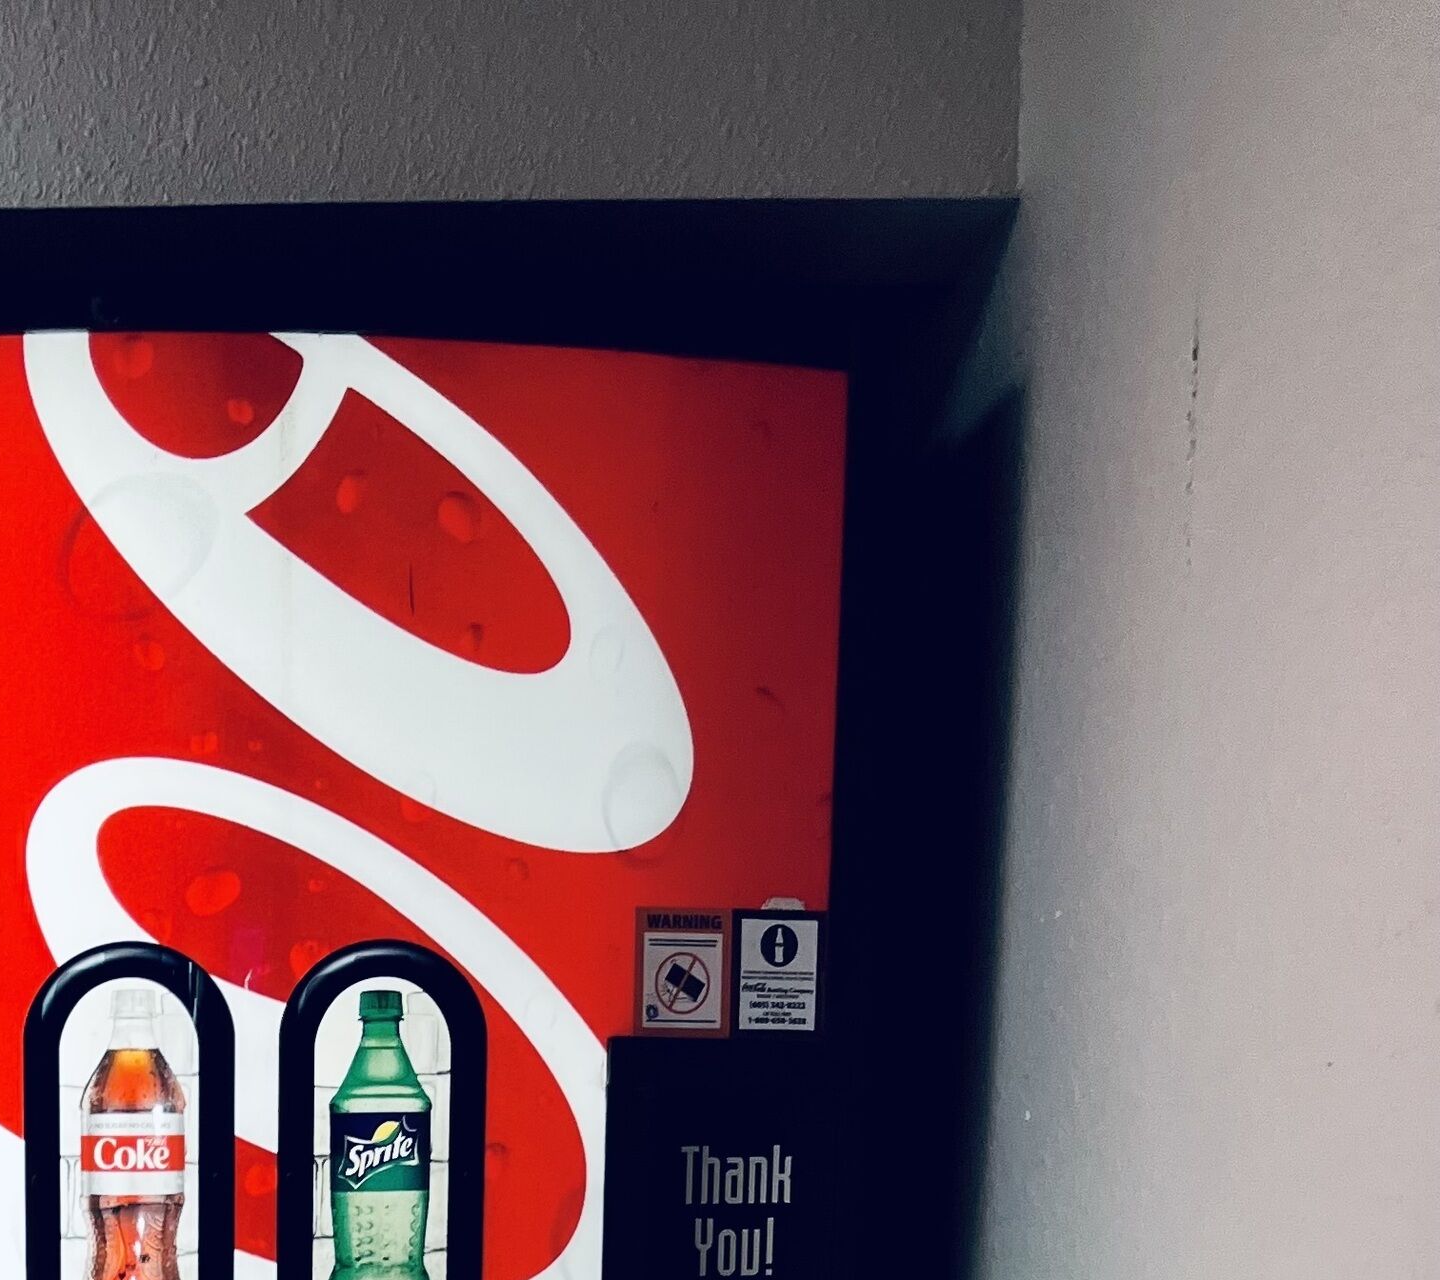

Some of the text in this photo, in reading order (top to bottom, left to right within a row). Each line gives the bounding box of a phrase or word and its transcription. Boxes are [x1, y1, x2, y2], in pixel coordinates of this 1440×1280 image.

[646, 913, 723, 930] WARNING
[93, 1136, 170, 1170] Coke
[345, 1129, 414, 1178] Sprite
[680, 1144, 793, 1205] Thank
[694, 1217, 775, 1277] You!
